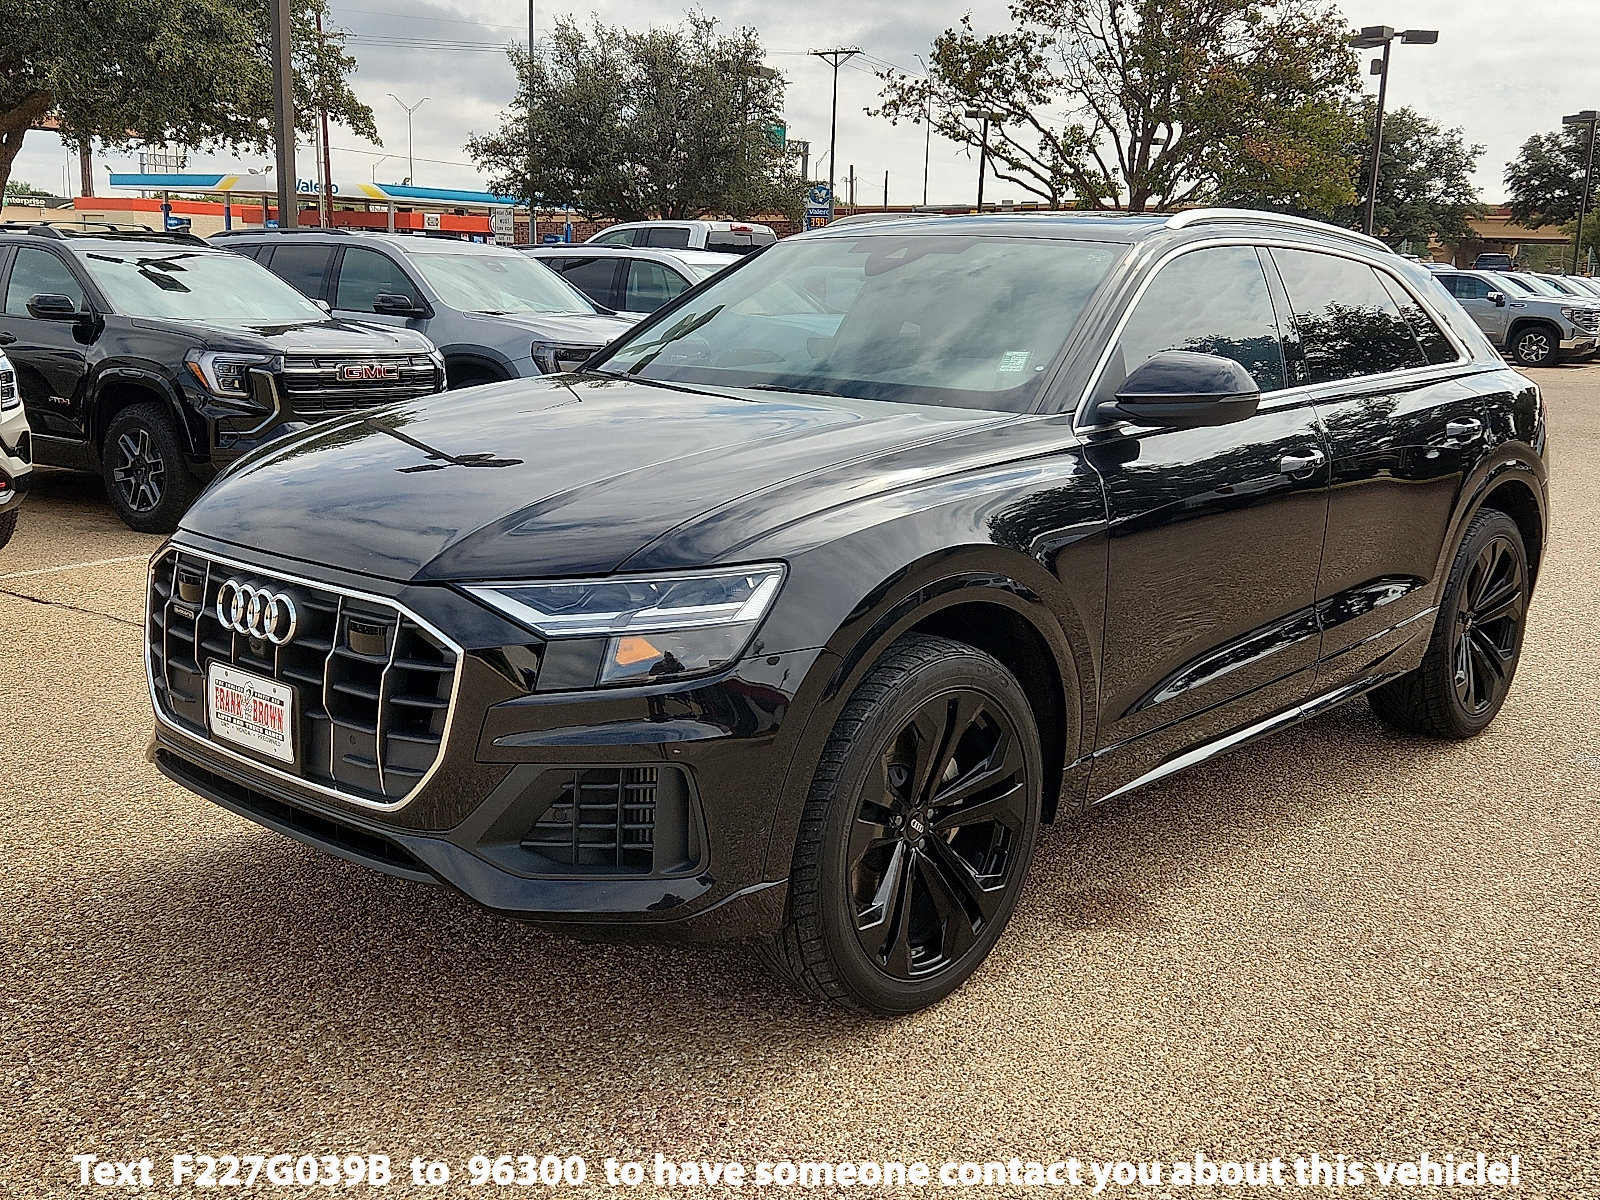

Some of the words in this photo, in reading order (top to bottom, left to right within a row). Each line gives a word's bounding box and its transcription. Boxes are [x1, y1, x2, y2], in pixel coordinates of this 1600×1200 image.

[344, 365, 398, 379] GMC
[215, 686, 243, 718] FRANK
[253, 699, 284, 733] BROWN
